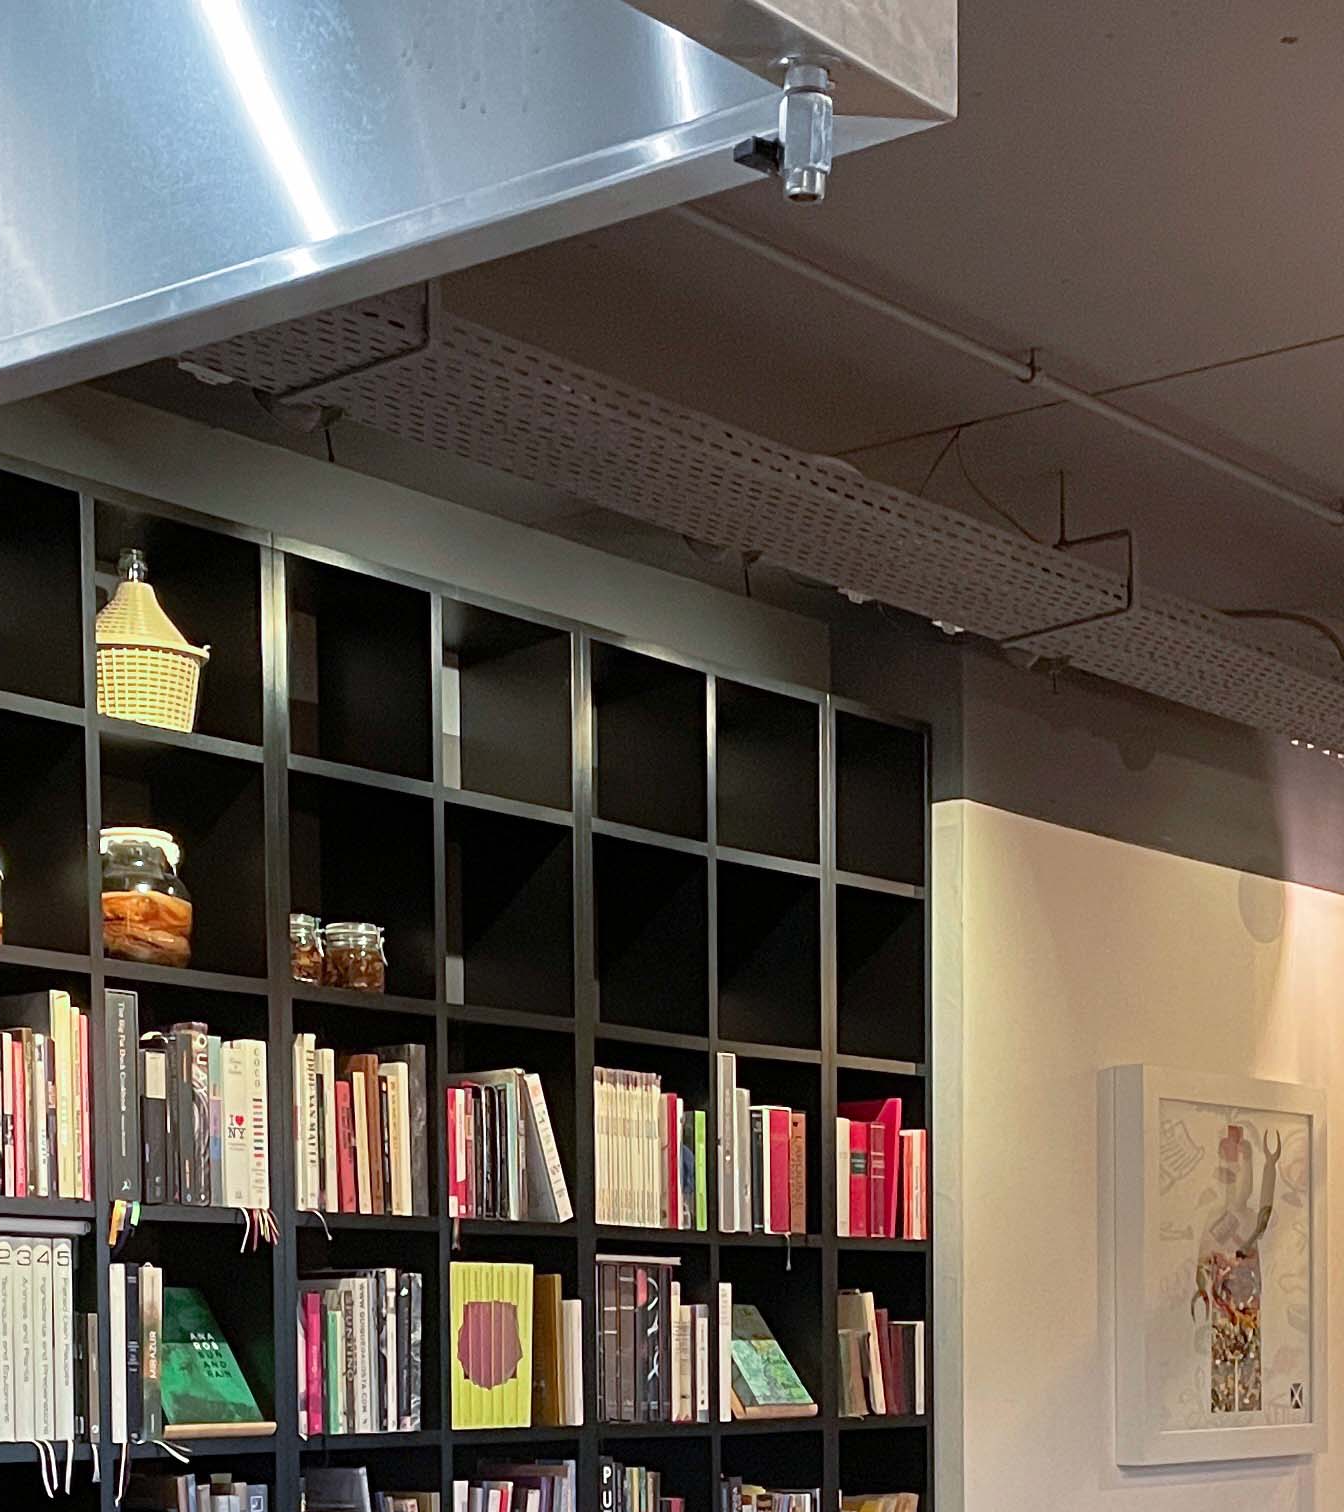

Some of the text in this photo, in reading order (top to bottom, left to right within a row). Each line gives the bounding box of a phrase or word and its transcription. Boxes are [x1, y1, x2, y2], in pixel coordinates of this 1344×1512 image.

[228, 1127, 247, 1140] NY
[16, 1249, 32, 1266] 3
[36, 1249, 50, 1265] 4
[56, 1250, 70, 1266] 5
[149, 1330, 157, 1380] MIRAZUR
